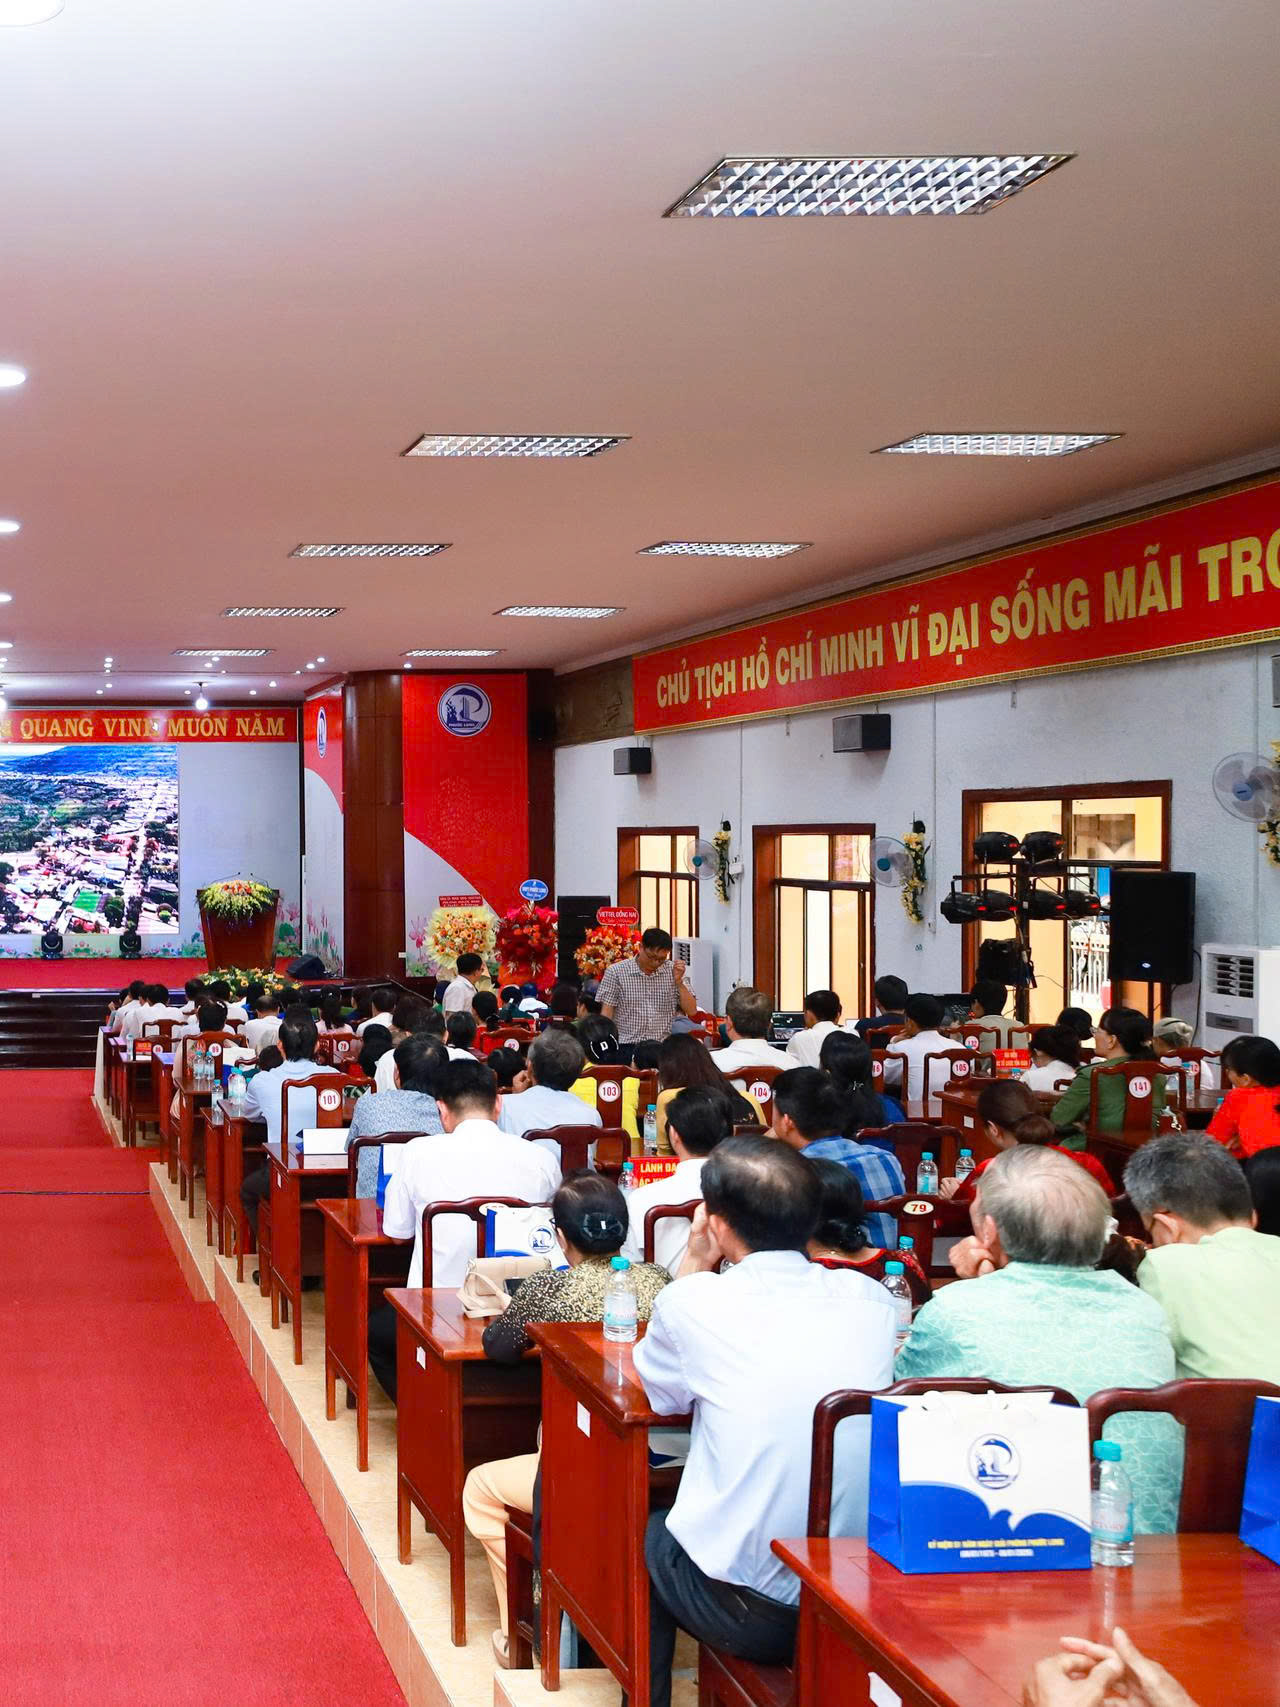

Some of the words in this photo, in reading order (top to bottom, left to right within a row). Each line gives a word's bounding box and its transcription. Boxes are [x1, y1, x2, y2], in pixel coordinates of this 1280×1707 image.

[656, 658, 690, 708] CHỦ
[694, 659, 736, 708] TỊCH
[742, 637, 769, 691] HỒ
[775, 630, 813, 685] CHÍ
[820, 625, 884, 676] MINH
[892, 604, 920, 663] VĨ
[927, 603, 979, 665] ĐẠI
[990, 567, 1090, 644] SỐNG
[1104, 543, 1182, 624] MÃI
[20, 719, 94, 740] QUANG
[168, 713, 228, 737] MUÔN
[236, 713, 285, 737] NĂM
[603, 1087, 617, 1096] 103
[754, 1087, 767, 1097] 104
[322, 1095, 336, 1104] 101
[640, 1161, 663, 1173] LÃNH
[911, 1204, 926, 1212] 79
